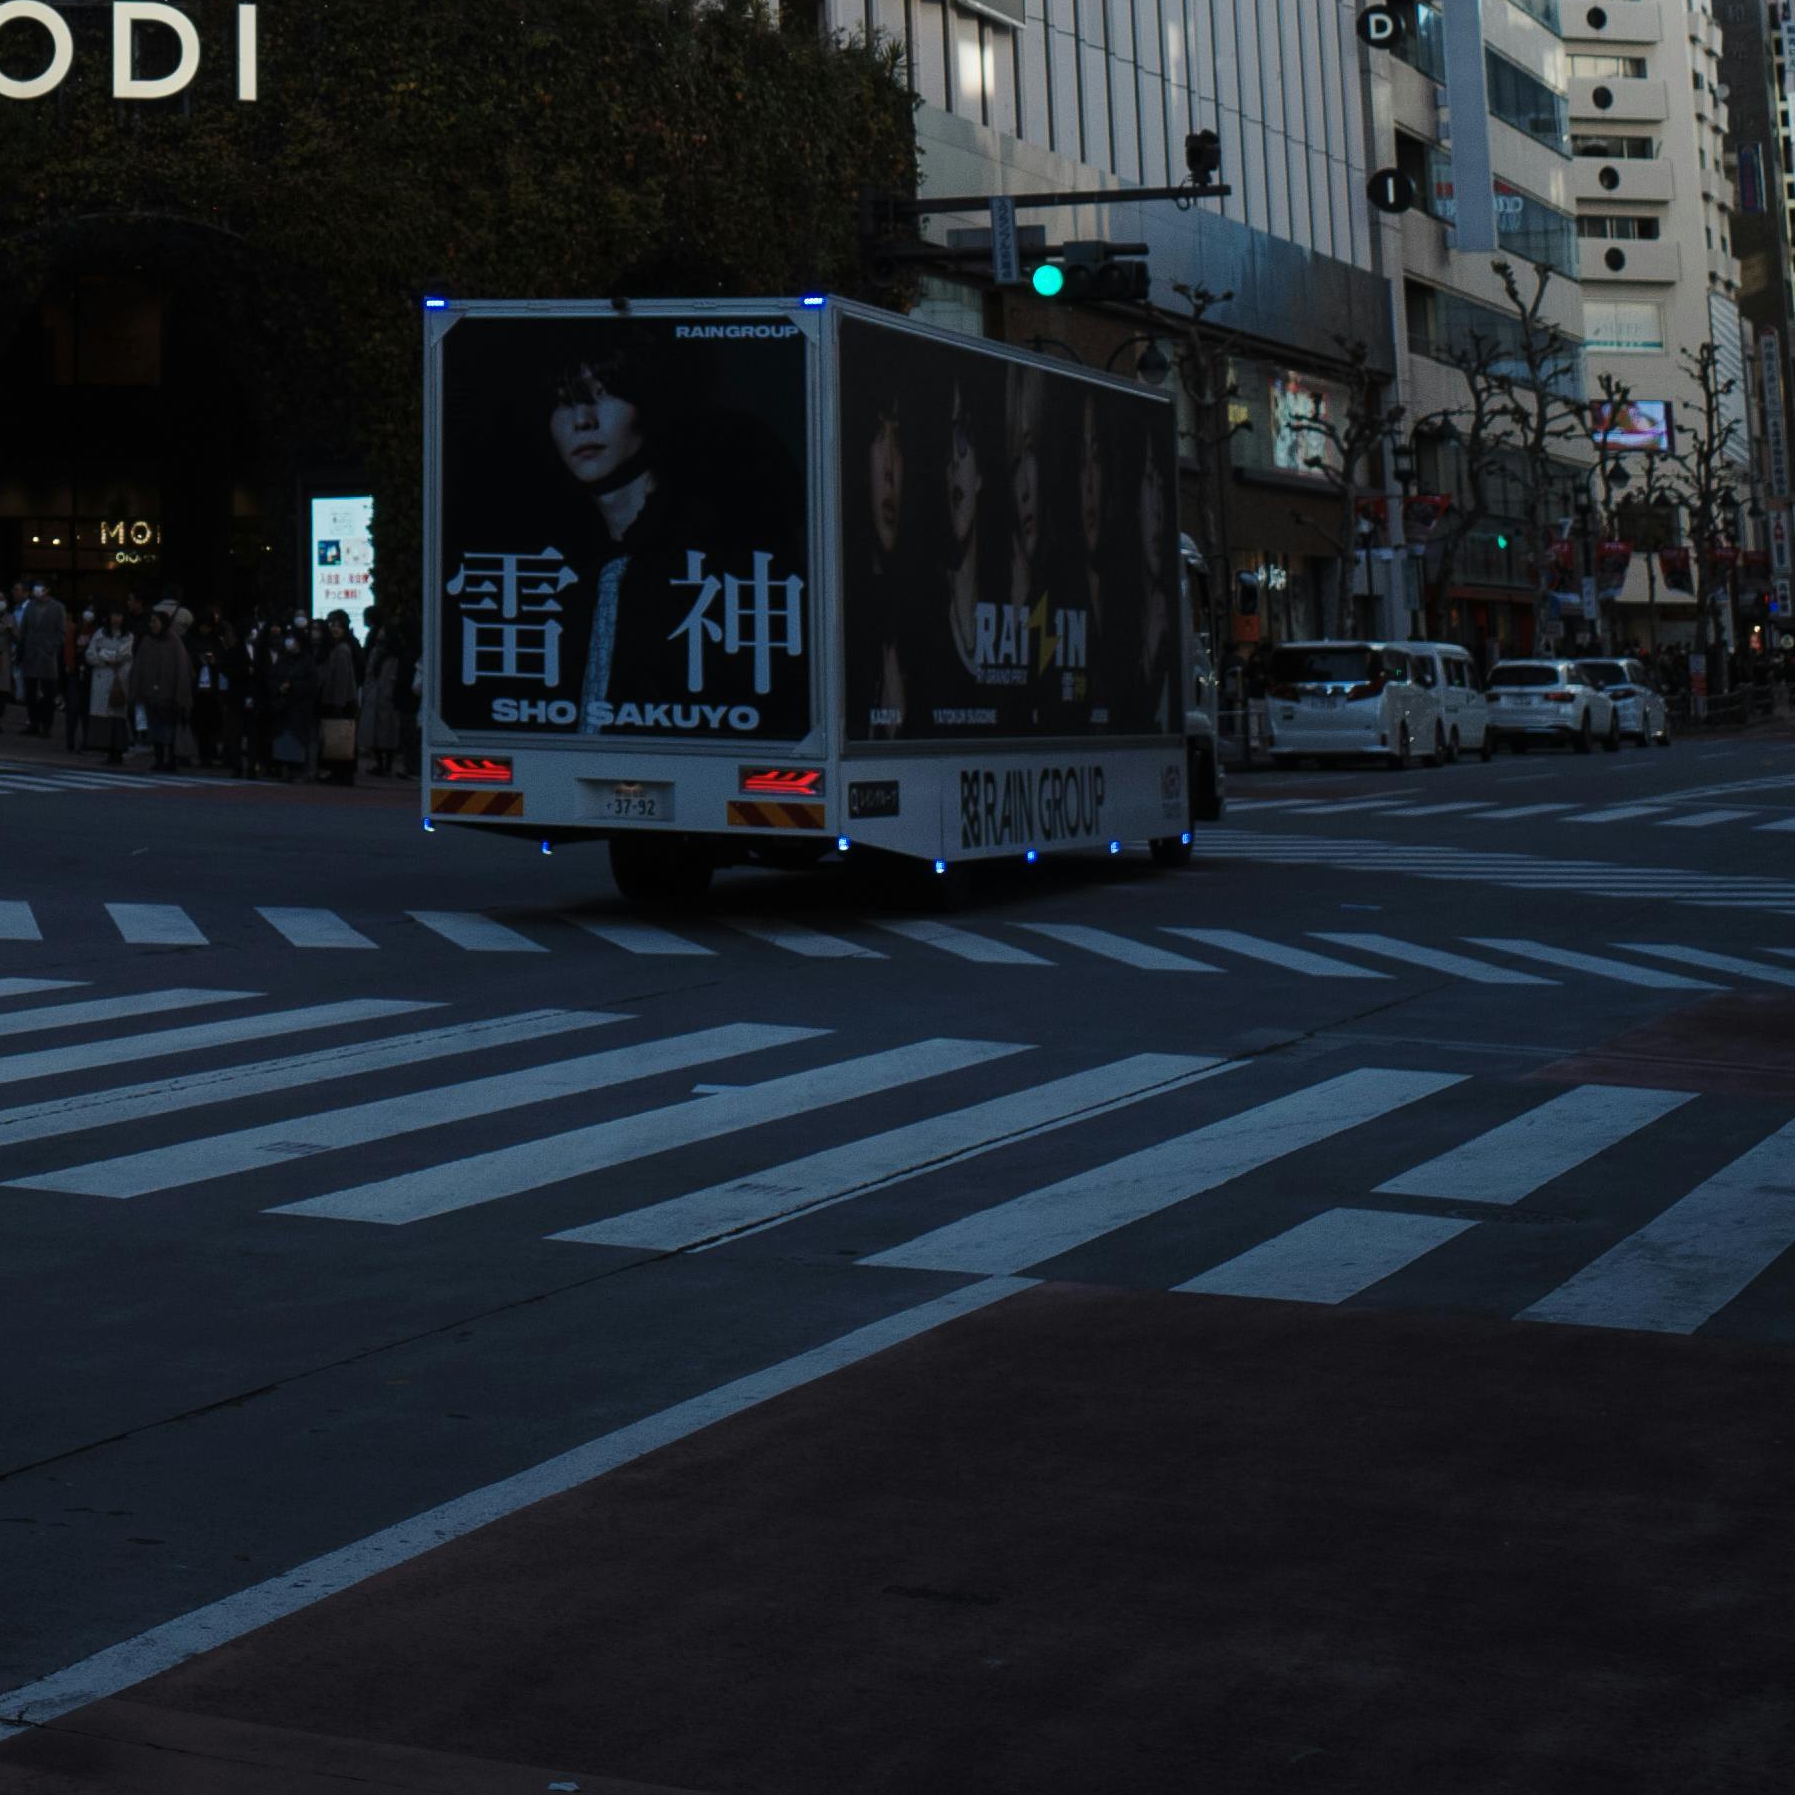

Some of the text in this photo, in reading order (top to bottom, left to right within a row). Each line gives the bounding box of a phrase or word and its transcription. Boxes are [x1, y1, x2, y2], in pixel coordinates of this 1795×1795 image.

[491, 696, 761, 731] SHO SAKUYO
[984, 769, 1035, 847] RAIN
[1038, 766, 1104, 842] GROUP
